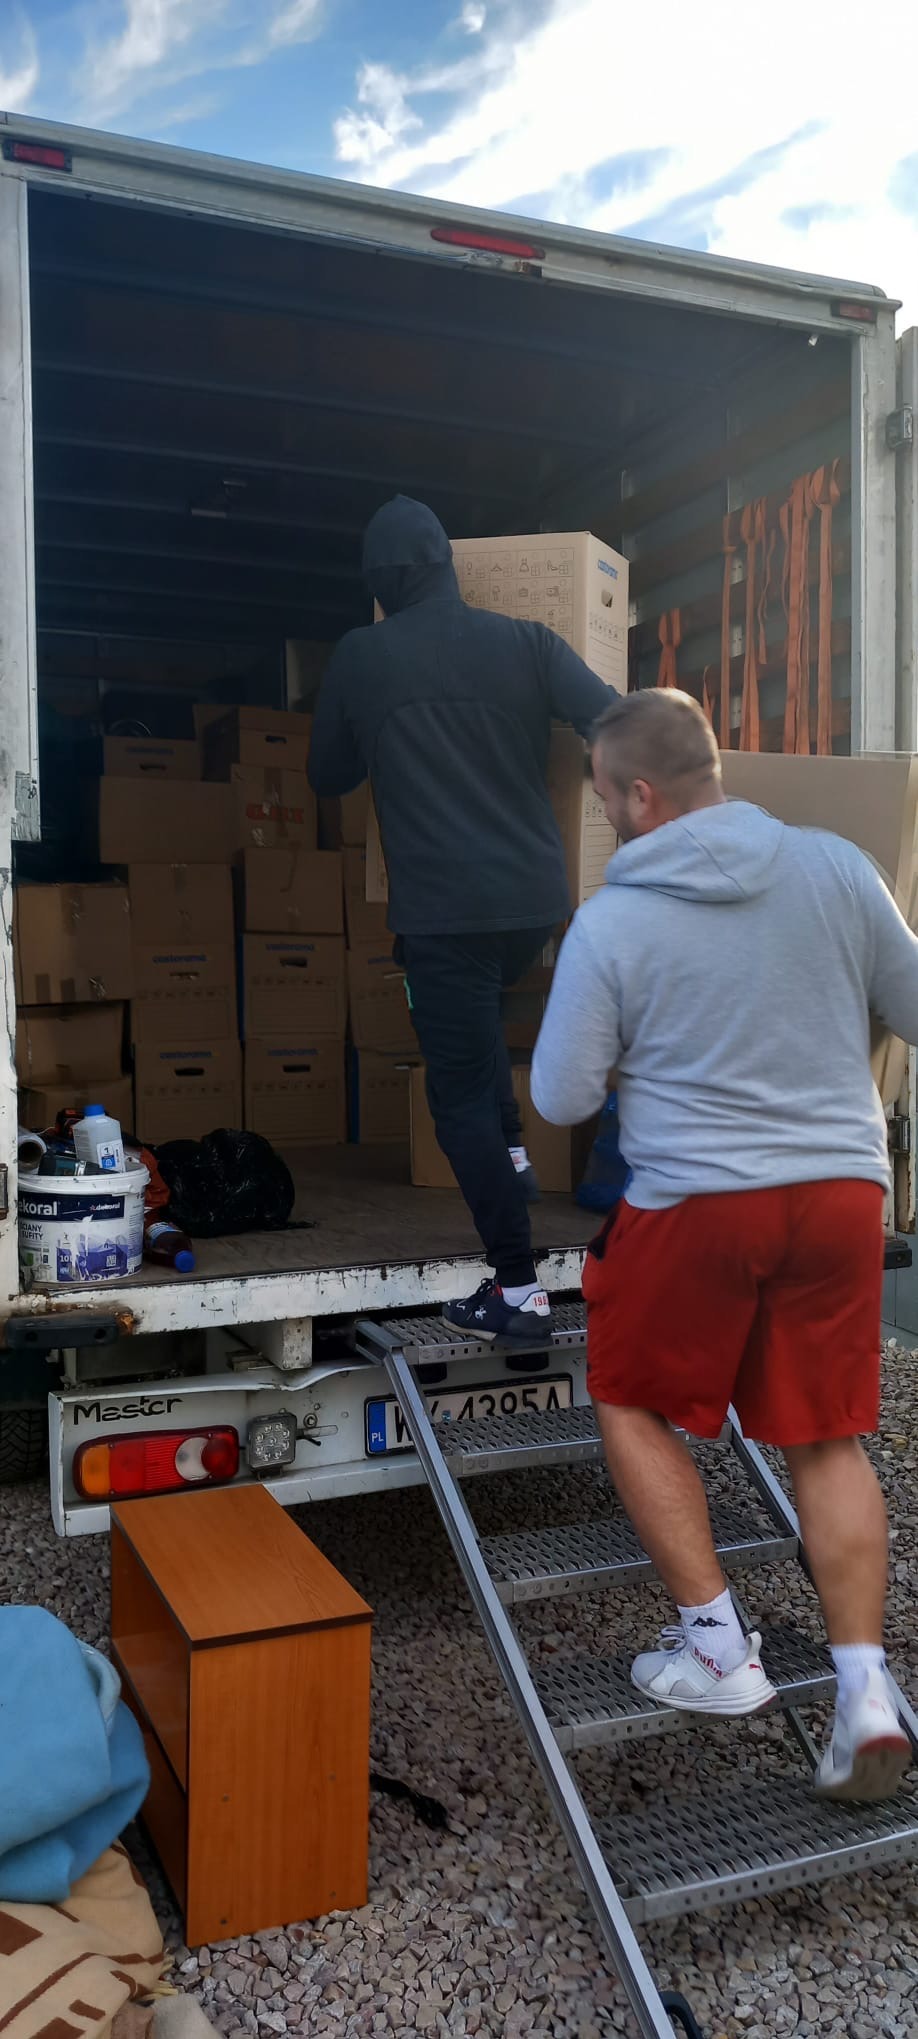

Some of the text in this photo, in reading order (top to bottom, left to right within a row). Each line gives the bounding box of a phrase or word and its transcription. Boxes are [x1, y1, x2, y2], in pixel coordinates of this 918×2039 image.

[18, 1199, 58, 1216] ekoral
[20, 1222, 42, 1233] CIANY
[73, 1396, 184, 1426] Master
[371, 1432, 384, 1444] PL
